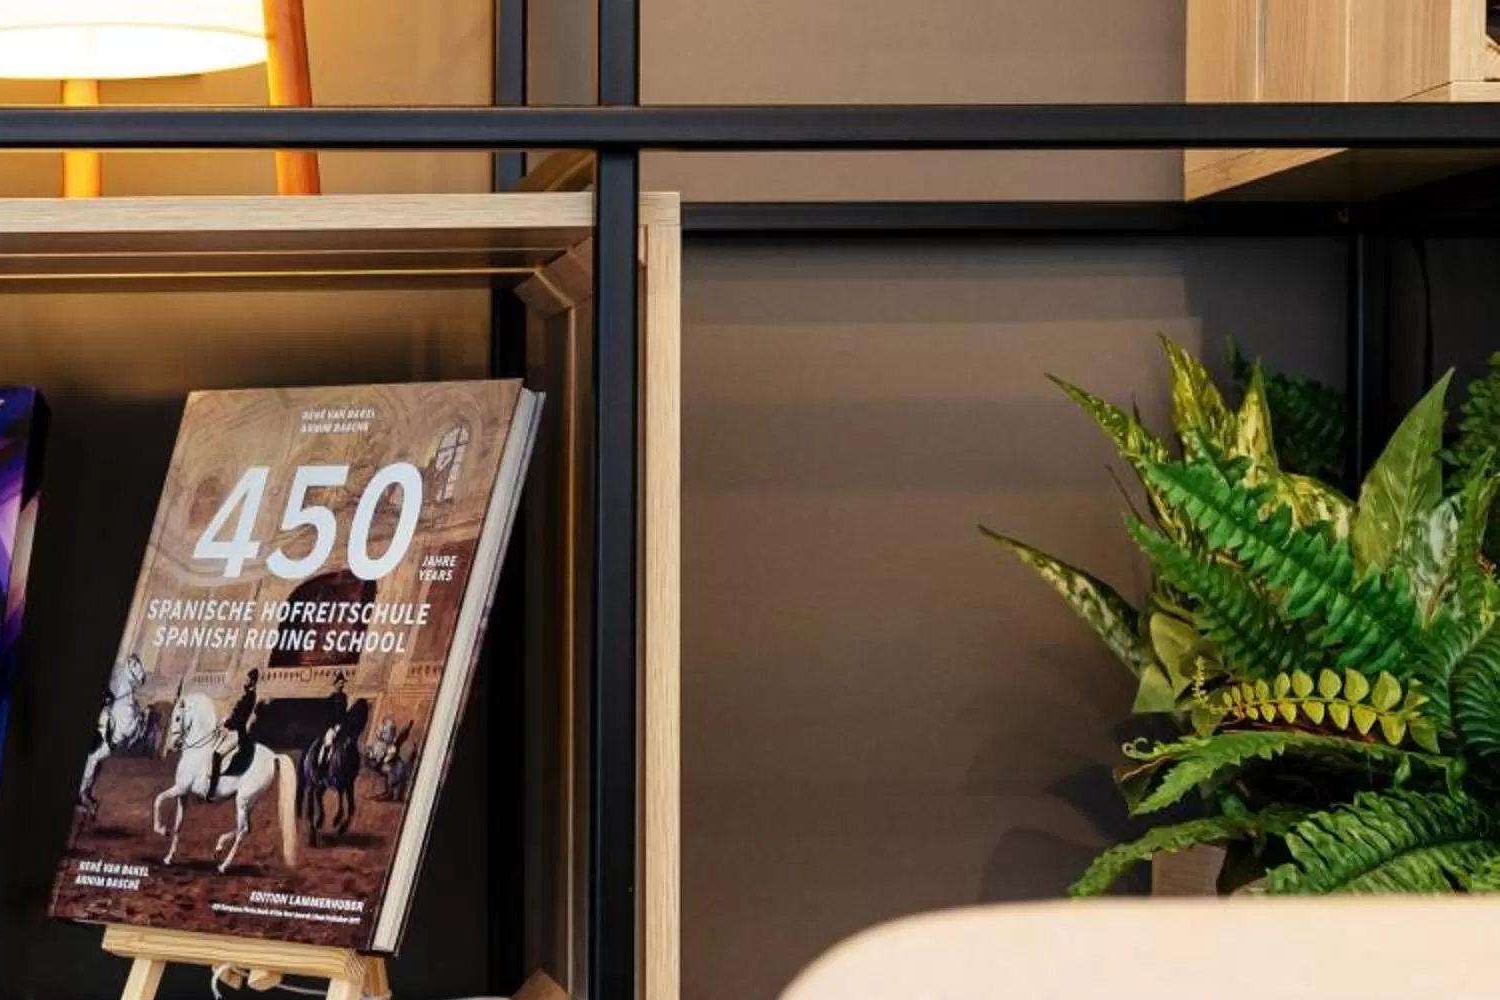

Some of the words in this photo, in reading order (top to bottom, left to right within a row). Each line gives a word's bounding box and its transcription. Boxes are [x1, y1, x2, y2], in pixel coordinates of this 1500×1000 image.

[193, 462, 423, 580] 450
[421, 555, 458, 568] JAHRE
[418, 569, 453, 582] YEARS
[147, 599, 256, 622] SPANISCHE
[261, 601, 431, 626] HOFREITSCHULE
[153, 626, 239, 649] SPANISH
[244, 628, 317, 651] RIDING
[322, 630, 406, 653] SCHOOL
